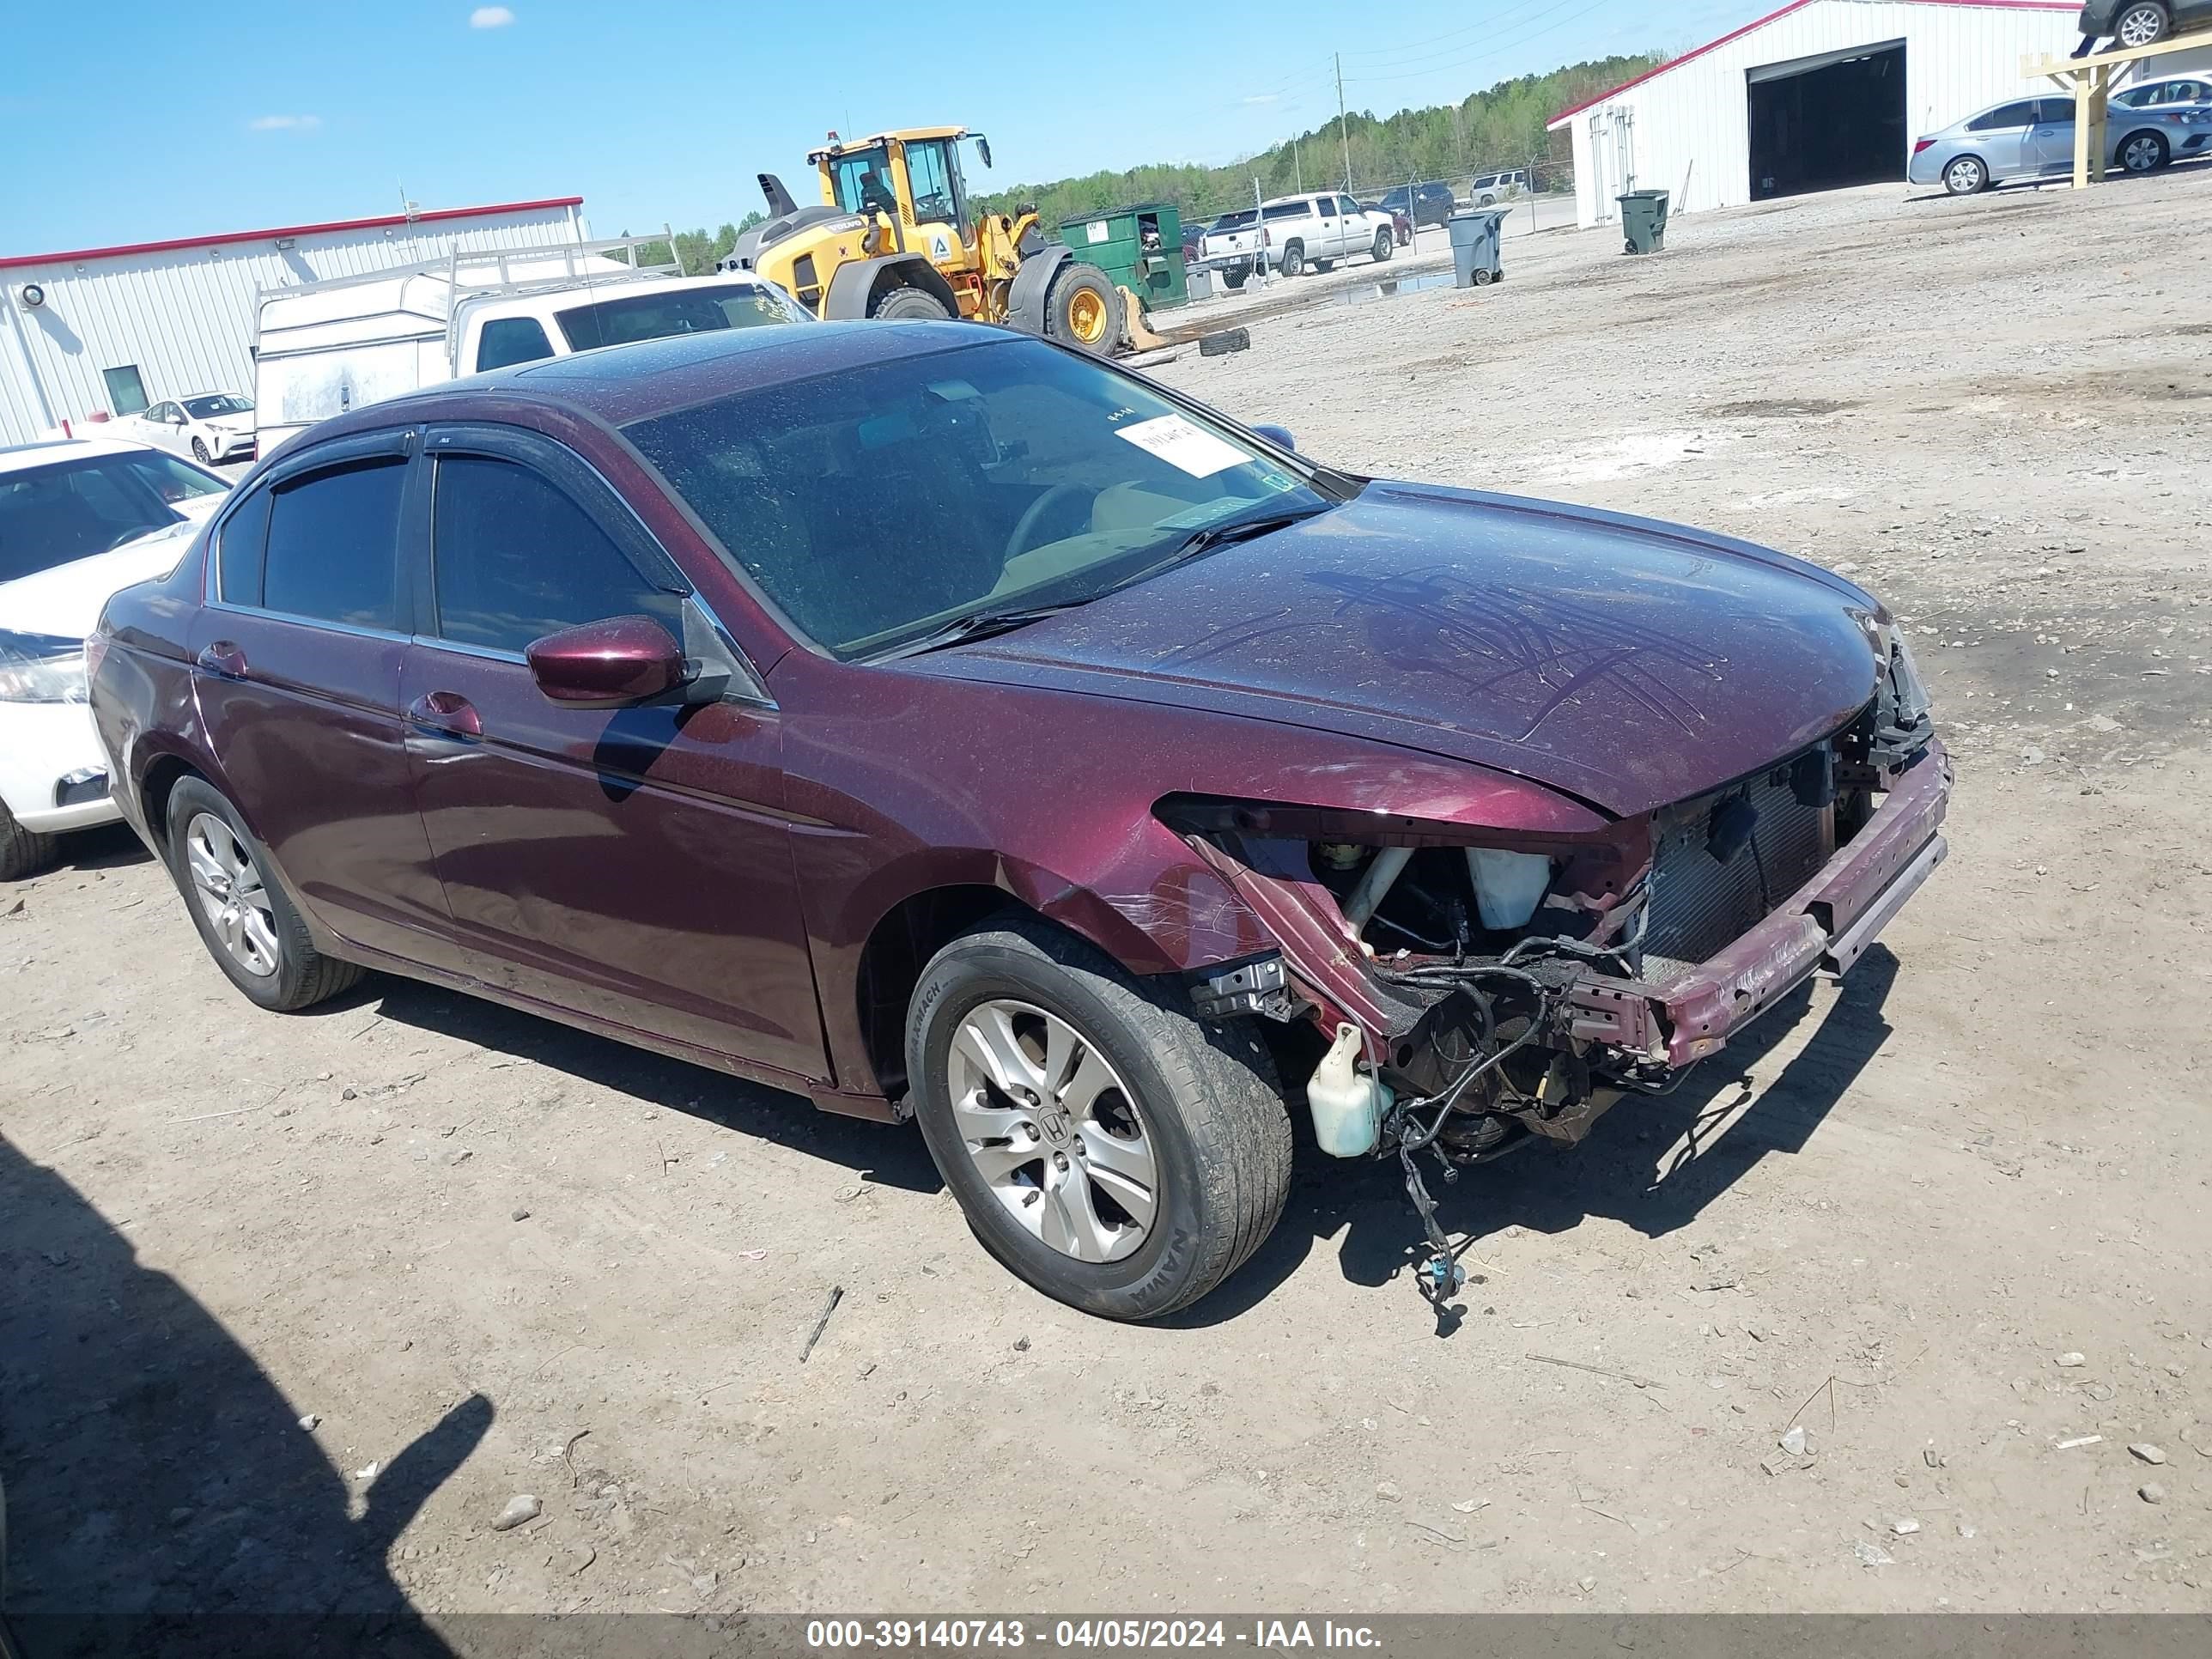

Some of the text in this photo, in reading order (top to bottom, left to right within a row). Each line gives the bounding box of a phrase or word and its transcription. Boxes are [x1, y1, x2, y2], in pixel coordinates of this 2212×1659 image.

[830, 220, 862, 231] VOLVO
[911, 981, 941, 1066] MAXMACH
[1127, 1227, 1188, 1304] NAMA
